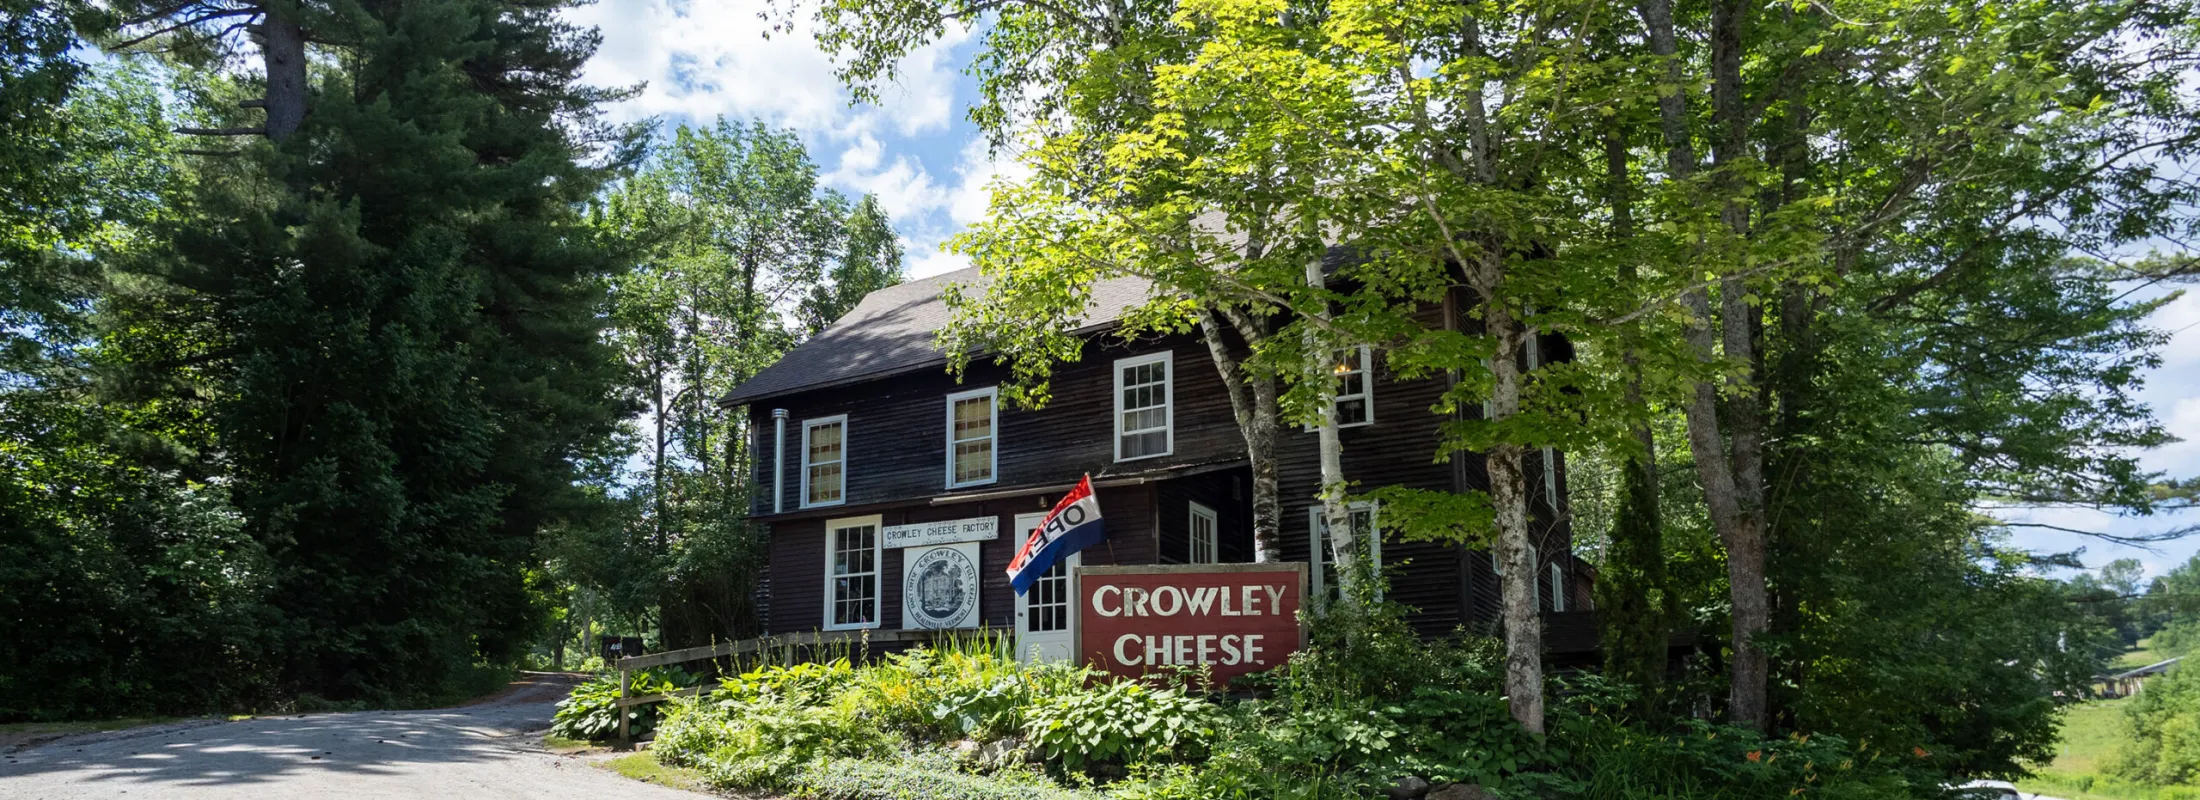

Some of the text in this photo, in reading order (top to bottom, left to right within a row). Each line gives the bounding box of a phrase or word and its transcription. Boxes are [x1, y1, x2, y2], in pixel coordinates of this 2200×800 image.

[887, 522, 995, 540] CROWLEY CHEESE FACTORY
[918, 550, 965, 568] CROWLEY
[965, 565, 975, 606] FULL CREAM
[1092, 584, 1287, 617] CROWLEY
[1113, 633, 1264, 666] CHEESE
